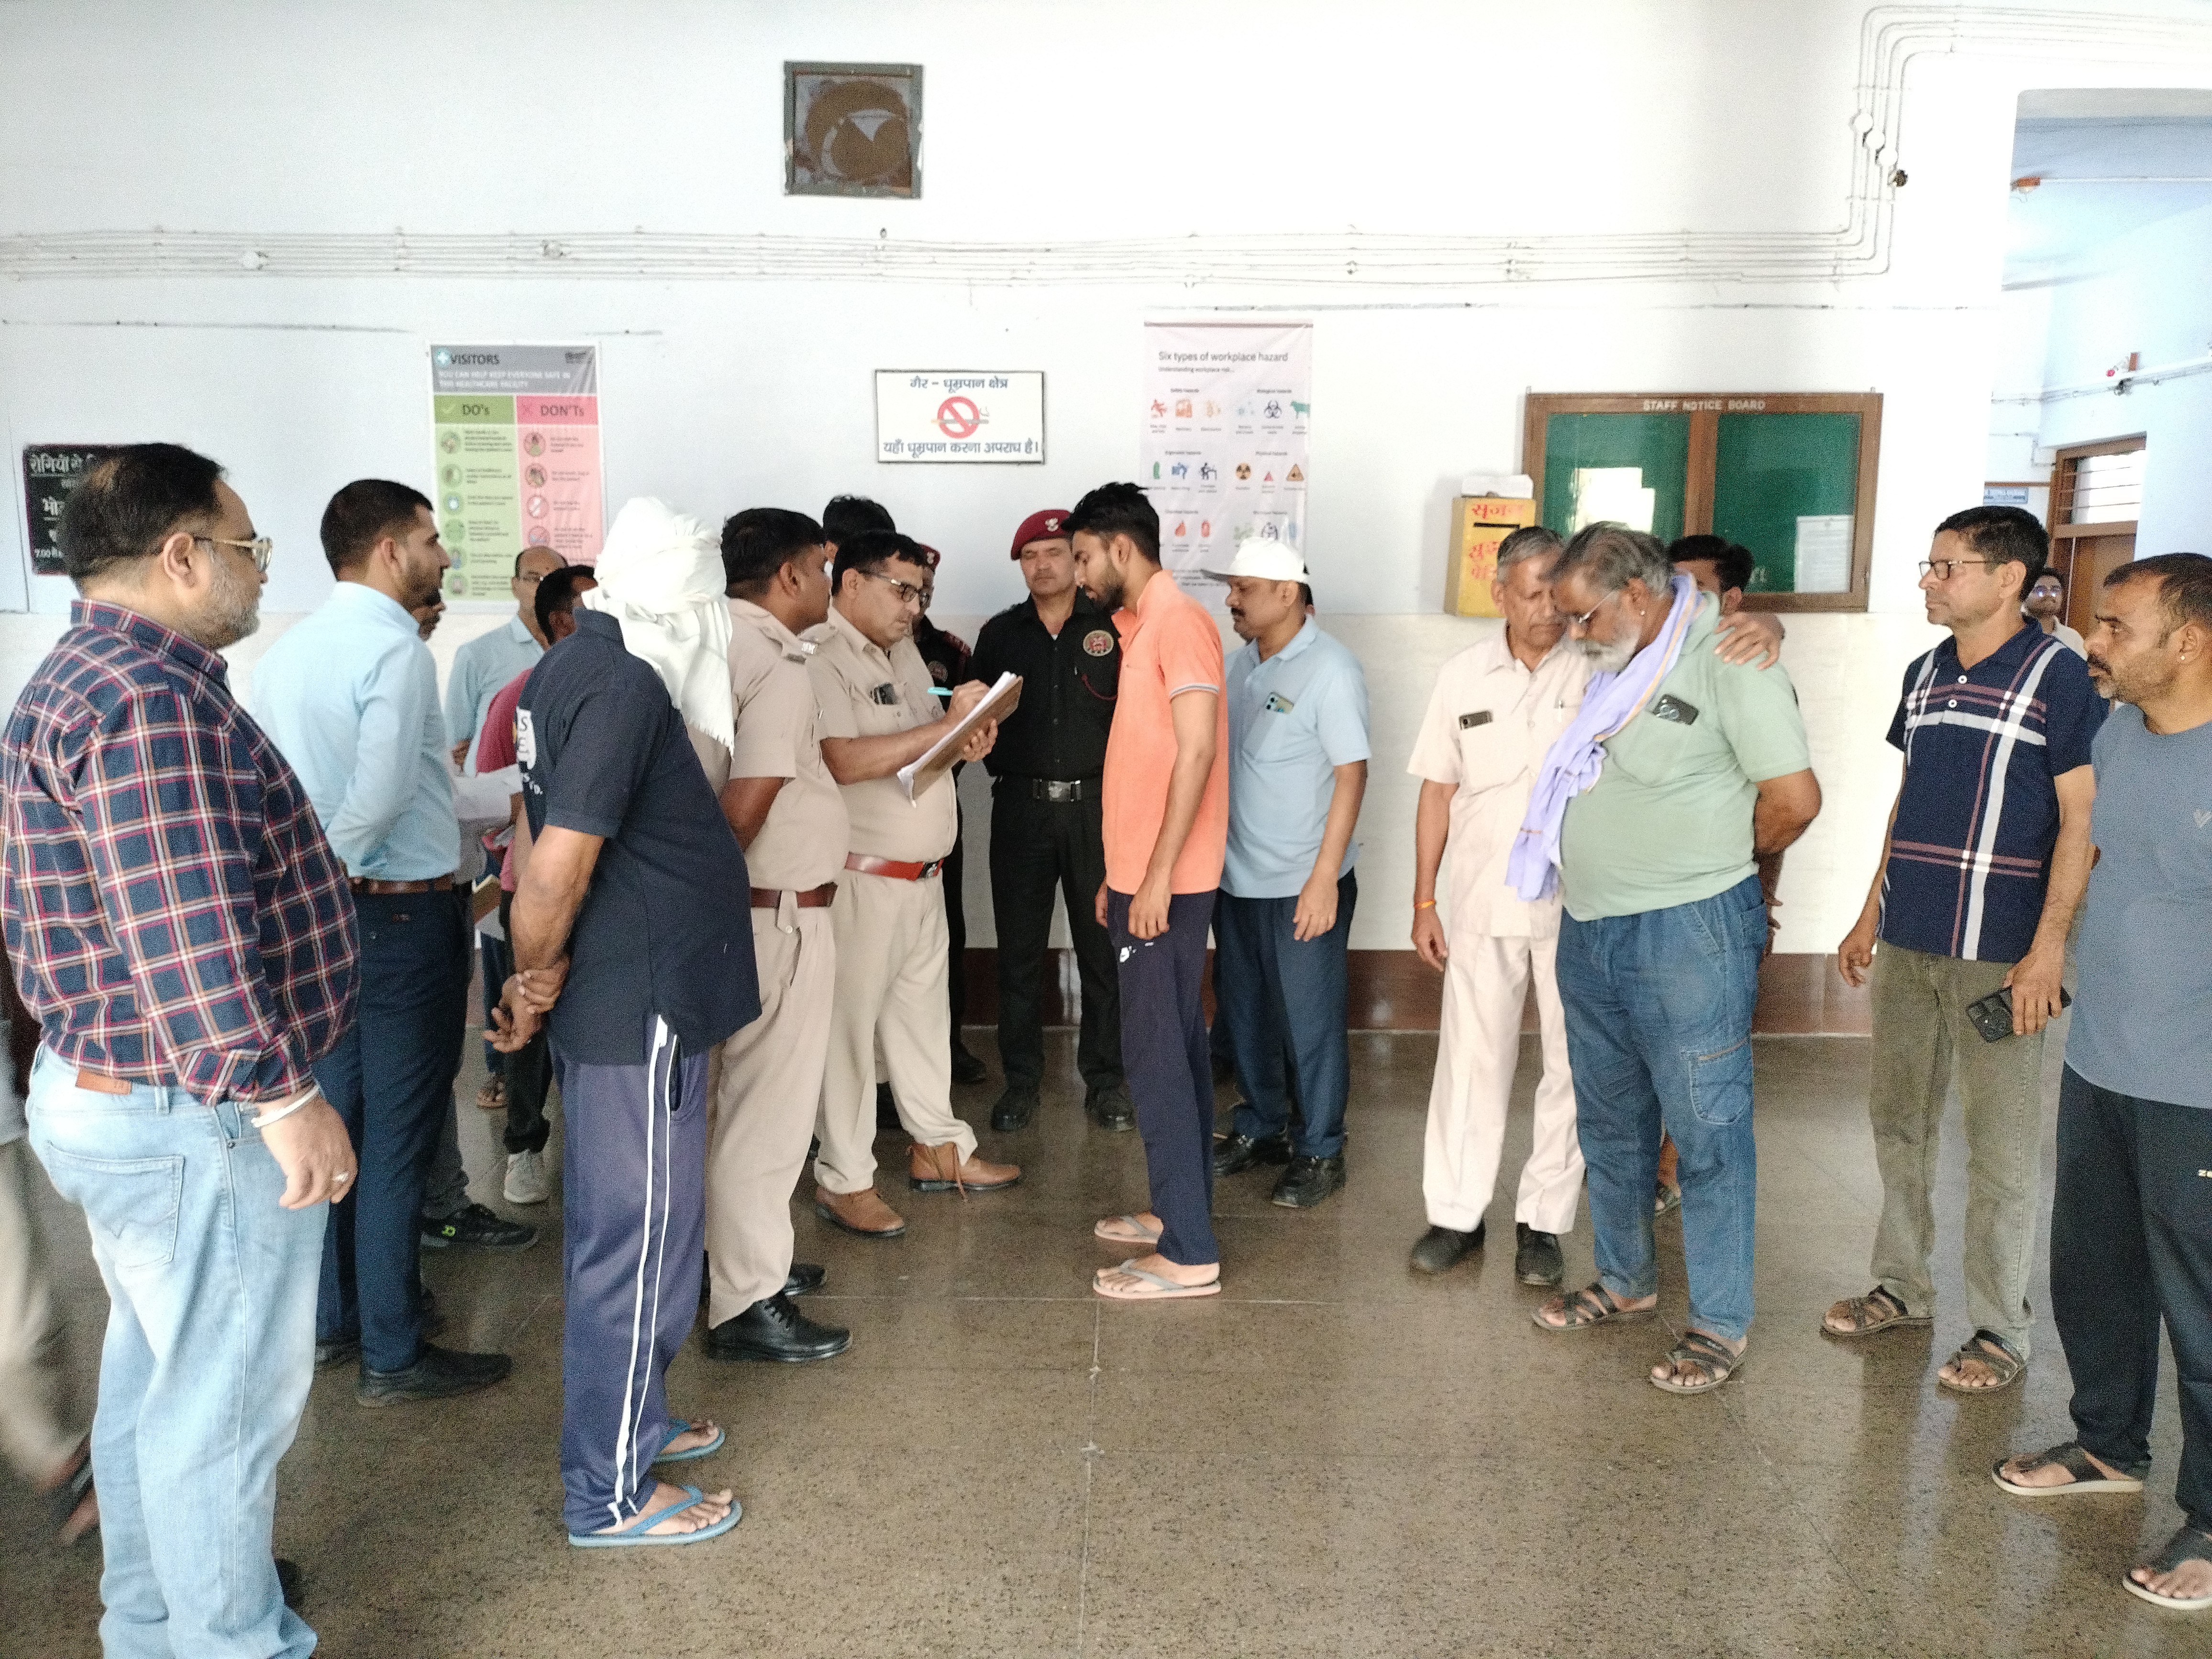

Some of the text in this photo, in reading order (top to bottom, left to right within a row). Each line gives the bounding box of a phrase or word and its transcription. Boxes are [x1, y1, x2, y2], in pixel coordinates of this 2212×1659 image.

[451, 354, 500, 365] VISITORS
[1159, 351, 1288, 363] Six types of workplace hazard
[910, 375, 929, 388] गैर
[462, 404, 490, 416] DO's
[1643, 399, 1766, 411] STAFF NOTICE BOARD
[950, 442, 981, 453] करना
[984, 442, 1022, 453] अपराध
